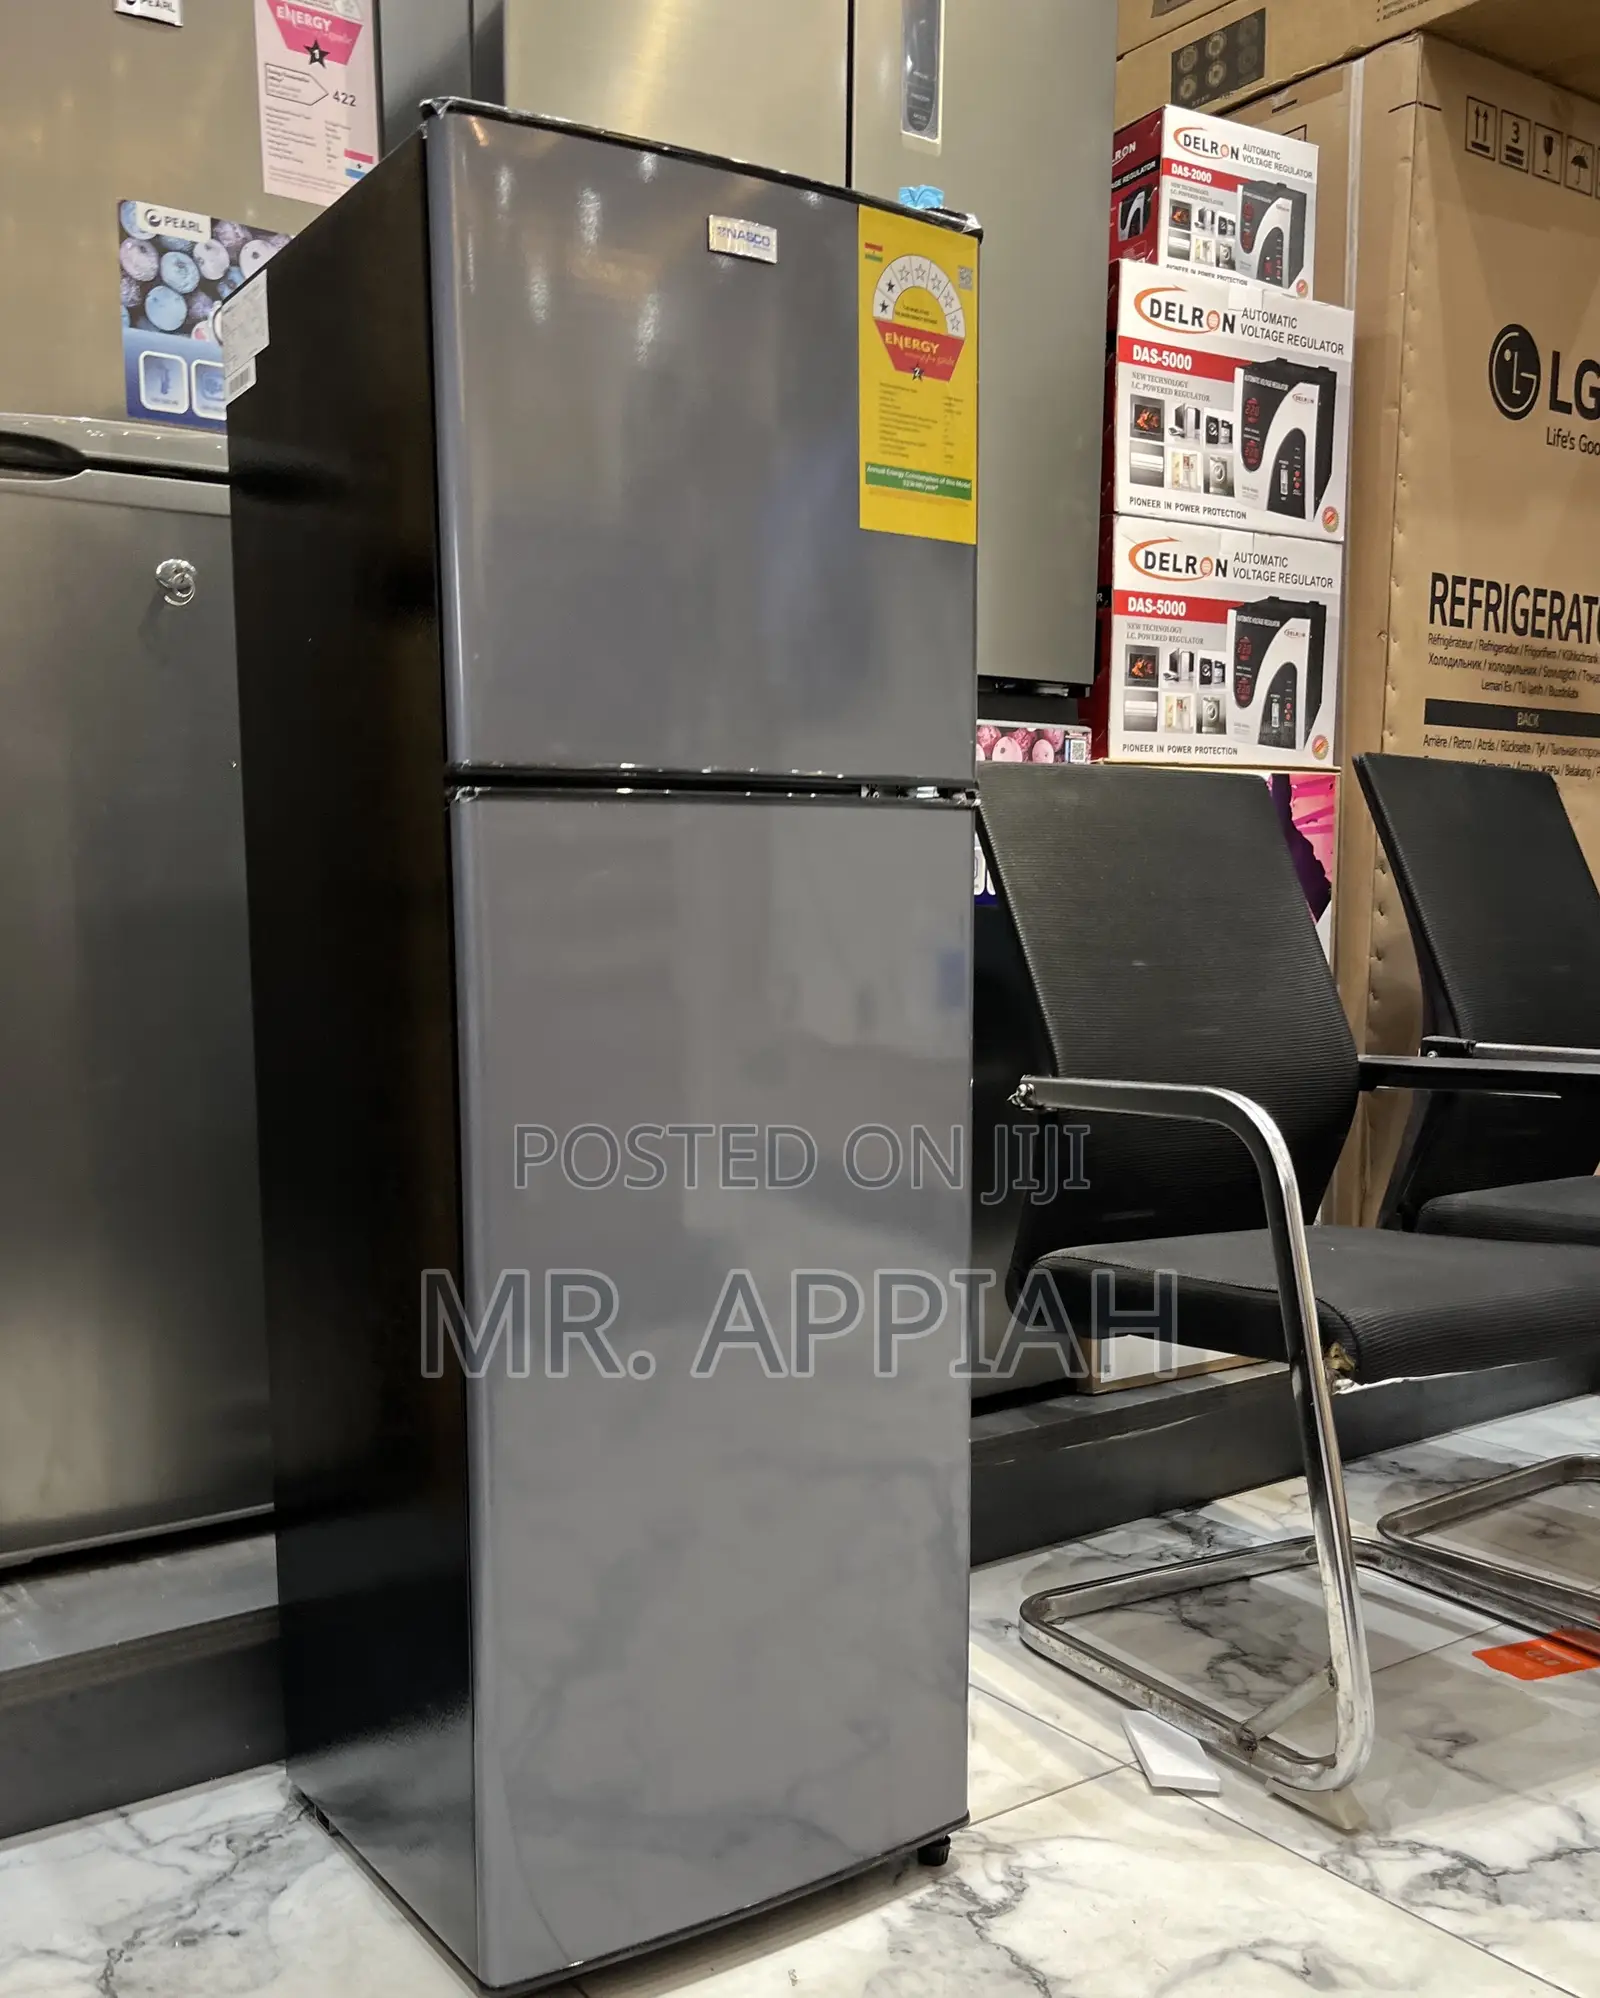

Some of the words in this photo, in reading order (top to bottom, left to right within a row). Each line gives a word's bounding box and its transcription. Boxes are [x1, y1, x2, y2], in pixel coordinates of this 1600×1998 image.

[276, 4, 332, 32] ENERGY
[332, 91, 357, 107] 422
[1511, 121, 1520, 144] 3
[1183, 134, 1239, 160] DELRON
[1243, 143, 1281, 160] AUTOMATIC
[1171, 163, 1212, 183] DAS-2000
[1242, 154, 1273, 170] VOLTAGE
[1274, 161, 1313, 180] REGULATOR
[164, 215, 203, 234] PEARL
[727, 228, 770, 247] NASCO
[1217, 274, 1248, 286] PROTECTION
[1150, 298, 1236, 335] DELRON
[1241, 306, 1298, 331] AUTOMATIC
[884, 332, 940, 354] ENERGY
[1240, 323, 1285, 345] VOLTAGE
[1287, 334, 1344, 356] REGULATOR
[1132, 344, 1192, 371] DAS-5000
[1132, 371, 1146, 382] NEW
[1147, 374, 1189, 389] TECHNOLOGY
[1143, 383, 1173, 396] POWERED
[1549, 350, 1600, 421] LG
[1546, 427, 1576, 451] Life's
[1129, 497, 1162, 509] PIONEER
[1164, 500, 1173, 510] IN
[1175, 502, 1200, 514] POWER
[1202, 505, 1248, 520] PROTECTION
[1144, 550, 1228, 578] DELRON
[1233, 551, 1289, 568] AUTOMATIC
[1232, 567, 1276, 583] VOLTAGE
[1278, 572, 1334, 589] REGULATOR
[1128, 597, 1187, 617] DAS-5000
[1429, 572, 1600, 645] REFRIGERAT
[1127, 622, 1141, 630] NEW
[1142, 623, 1183, 634] TECHNOLOGY
[1138, 632, 1168, 642] POWERED
[1168, 635, 1204, 645] REGULATOR
[1428, 632, 1474, 650] Réfrigérateur
[1428, 652, 1482, 670] Холодильник
[1517, 711, 1540, 728] BACK
[1123, 743, 1154, 753] PIONEER
[1156, 744, 1164, 753] IN
[1167, 745, 1192, 754] POWER
[1194, 746, 1238, 755] PROTECTION
